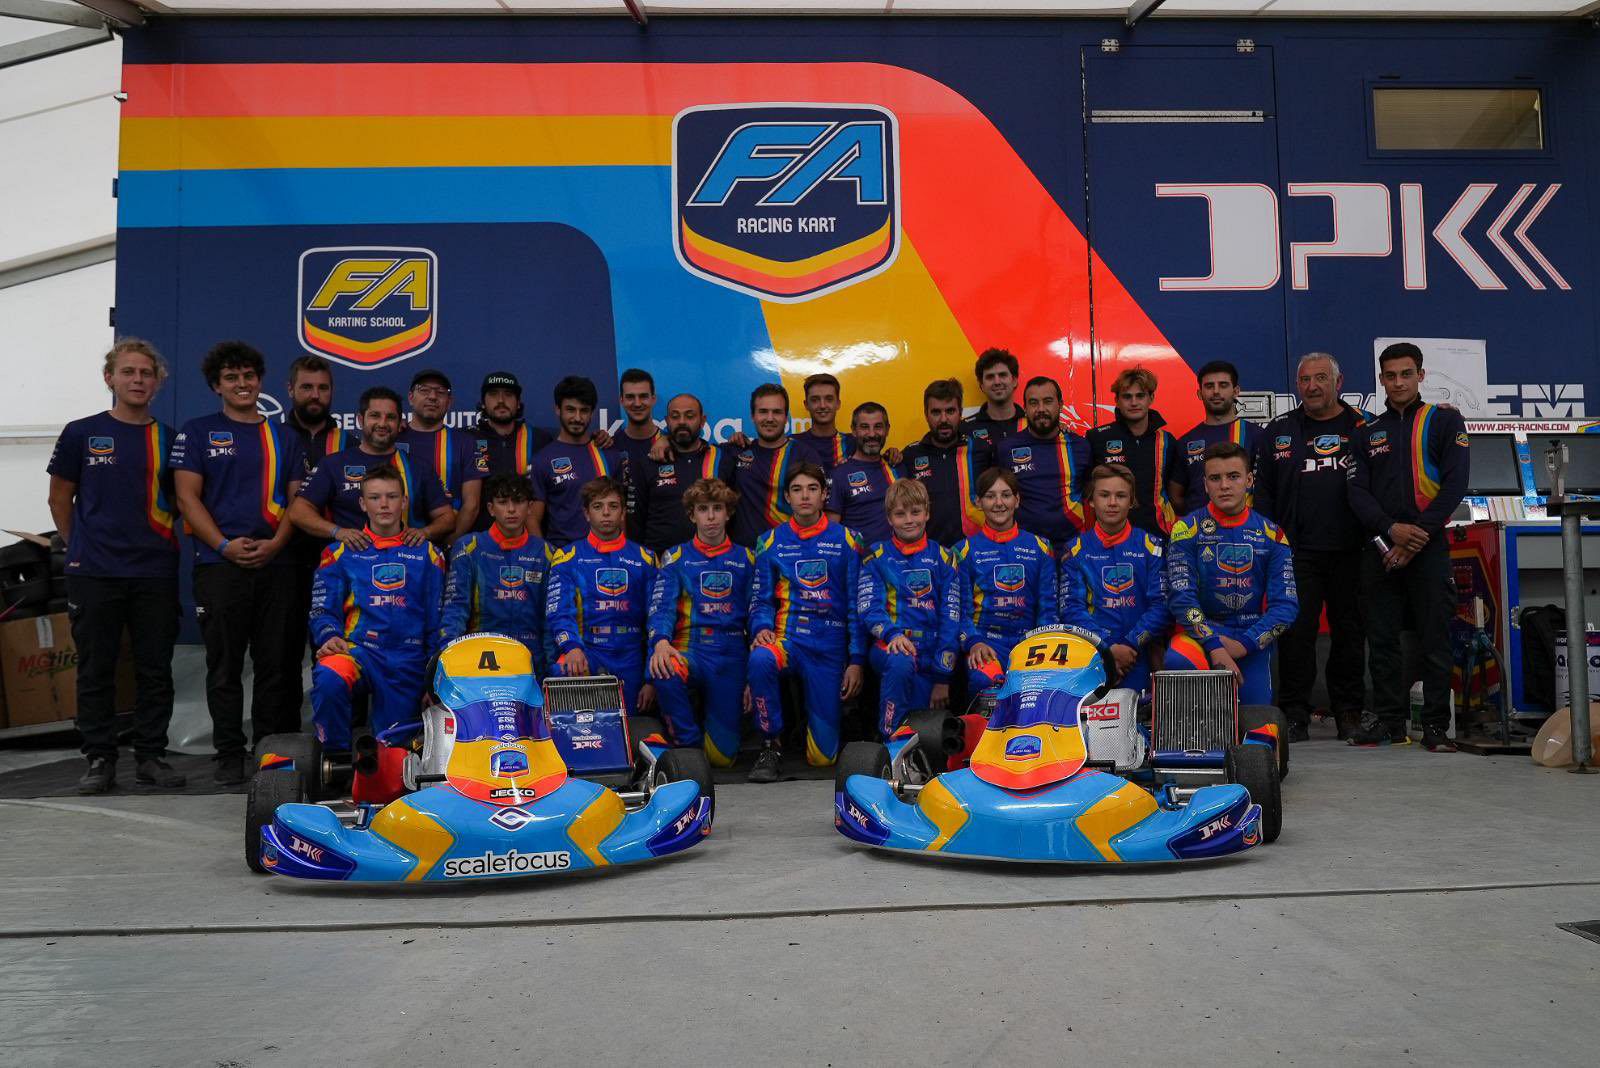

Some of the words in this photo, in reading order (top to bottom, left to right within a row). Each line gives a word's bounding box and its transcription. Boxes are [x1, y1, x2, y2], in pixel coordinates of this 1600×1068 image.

[685, 120, 888, 206] FA
[737, 217, 793, 233] RACING
[798, 217, 836, 232] KART
[307, 258, 430, 311] FA
[328, 316, 367, 327] KARTING
[370, 316, 406, 327] SCHOOL
[1466, 422, 1570, 432] WWW.DPK-RACING.COM
[478, 651, 500, 671] 4
[1025, 644, 1069, 667] 54
[1081, 705, 1119, 719] CKO
[490, 789, 535, 798] JECKO
[1198, 815, 1232, 840] DPK
[288, 836, 324, 863] DPK
[443, 851, 570, 879] scalefocus
